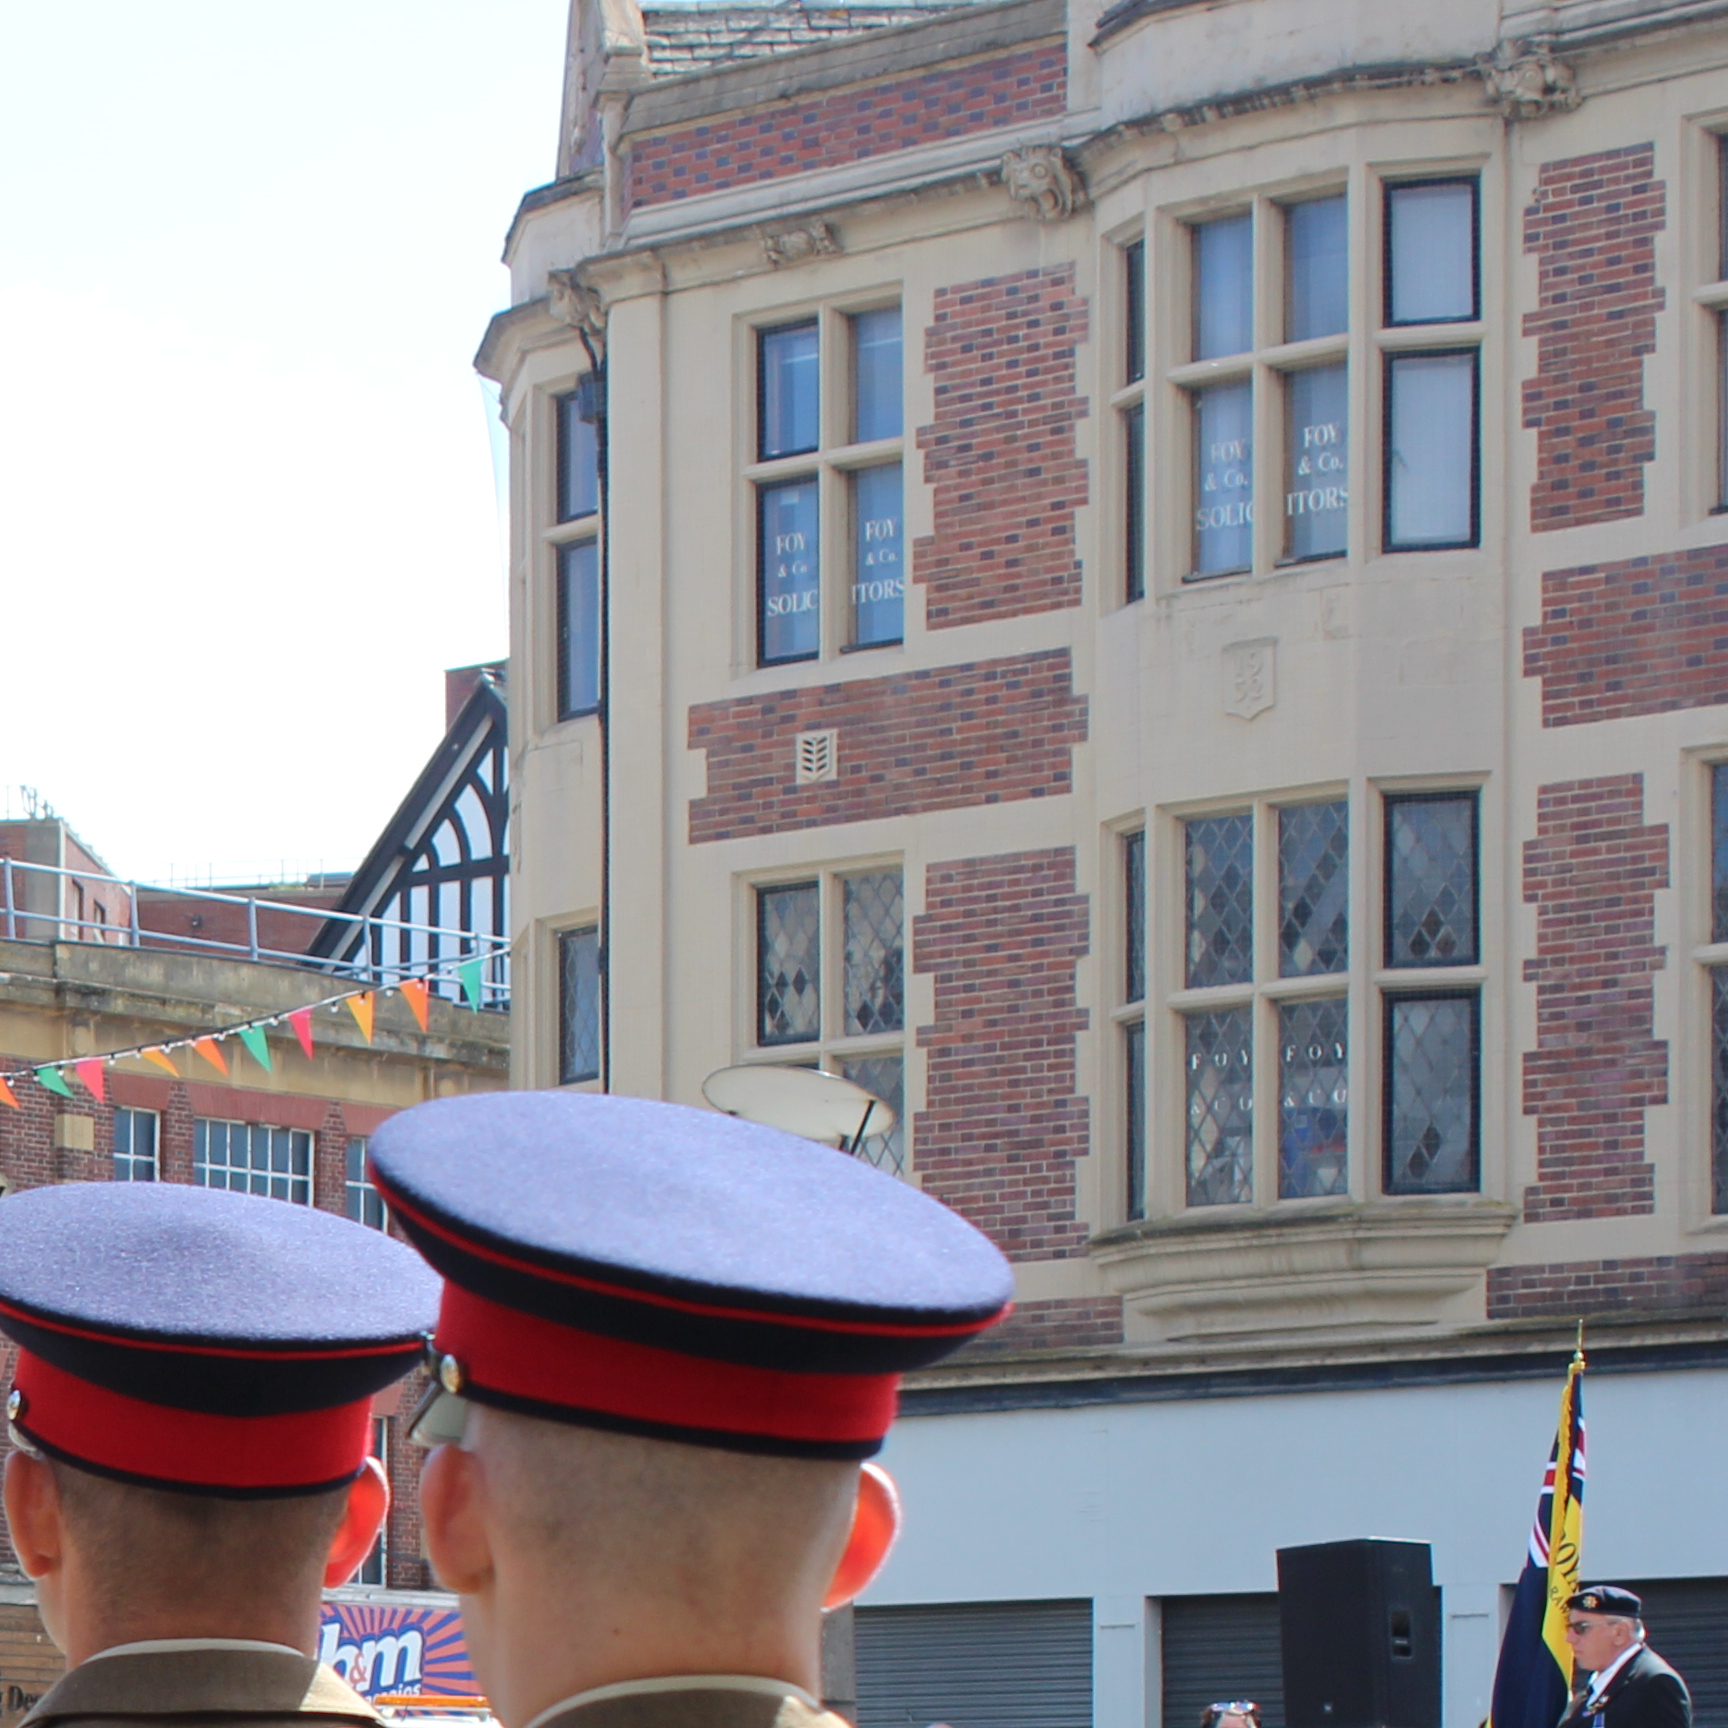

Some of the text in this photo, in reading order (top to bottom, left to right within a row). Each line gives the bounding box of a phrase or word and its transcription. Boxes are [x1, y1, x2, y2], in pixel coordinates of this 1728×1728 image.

[1303, 422, 1340, 449] FOY
[1210, 438, 1246, 464] FOY
[1298, 456, 1312, 476] &
[1204, 472, 1217, 491] &
[1287, 486, 1349, 516] ITORS
[865, 517, 897, 542] FOY
[776, 532, 806, 555] FOY
[778, 563, 787, 578] &
[865, 552, 875, 566] &
[767, 589, 818, 617] SOLIC
[852, 578, 905, 605] ITORS
